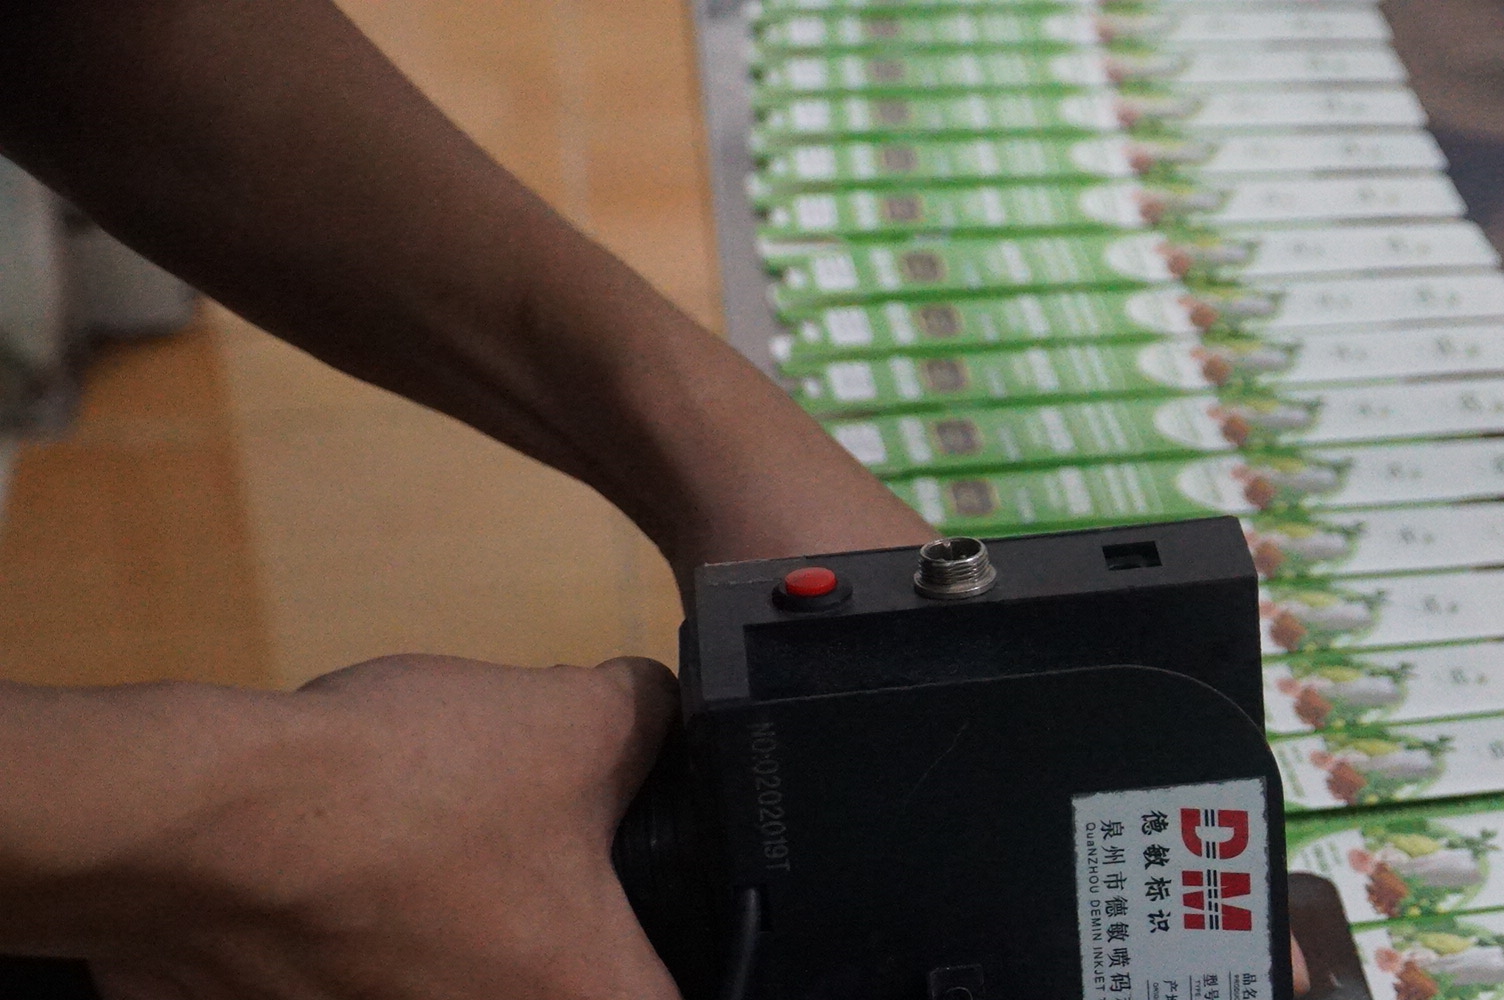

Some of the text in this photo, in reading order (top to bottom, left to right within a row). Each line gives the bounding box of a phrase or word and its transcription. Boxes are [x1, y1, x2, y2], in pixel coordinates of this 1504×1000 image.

[1086, 822, 1100, 894] QuaNZHOU
[1141, 810, 1172, 934] 德敏标识
[1180, 808, 1253, 931] DM
[1090, 900, 1103, 942] DEMIN
[1093, 946, 1106, 991] INKJET
